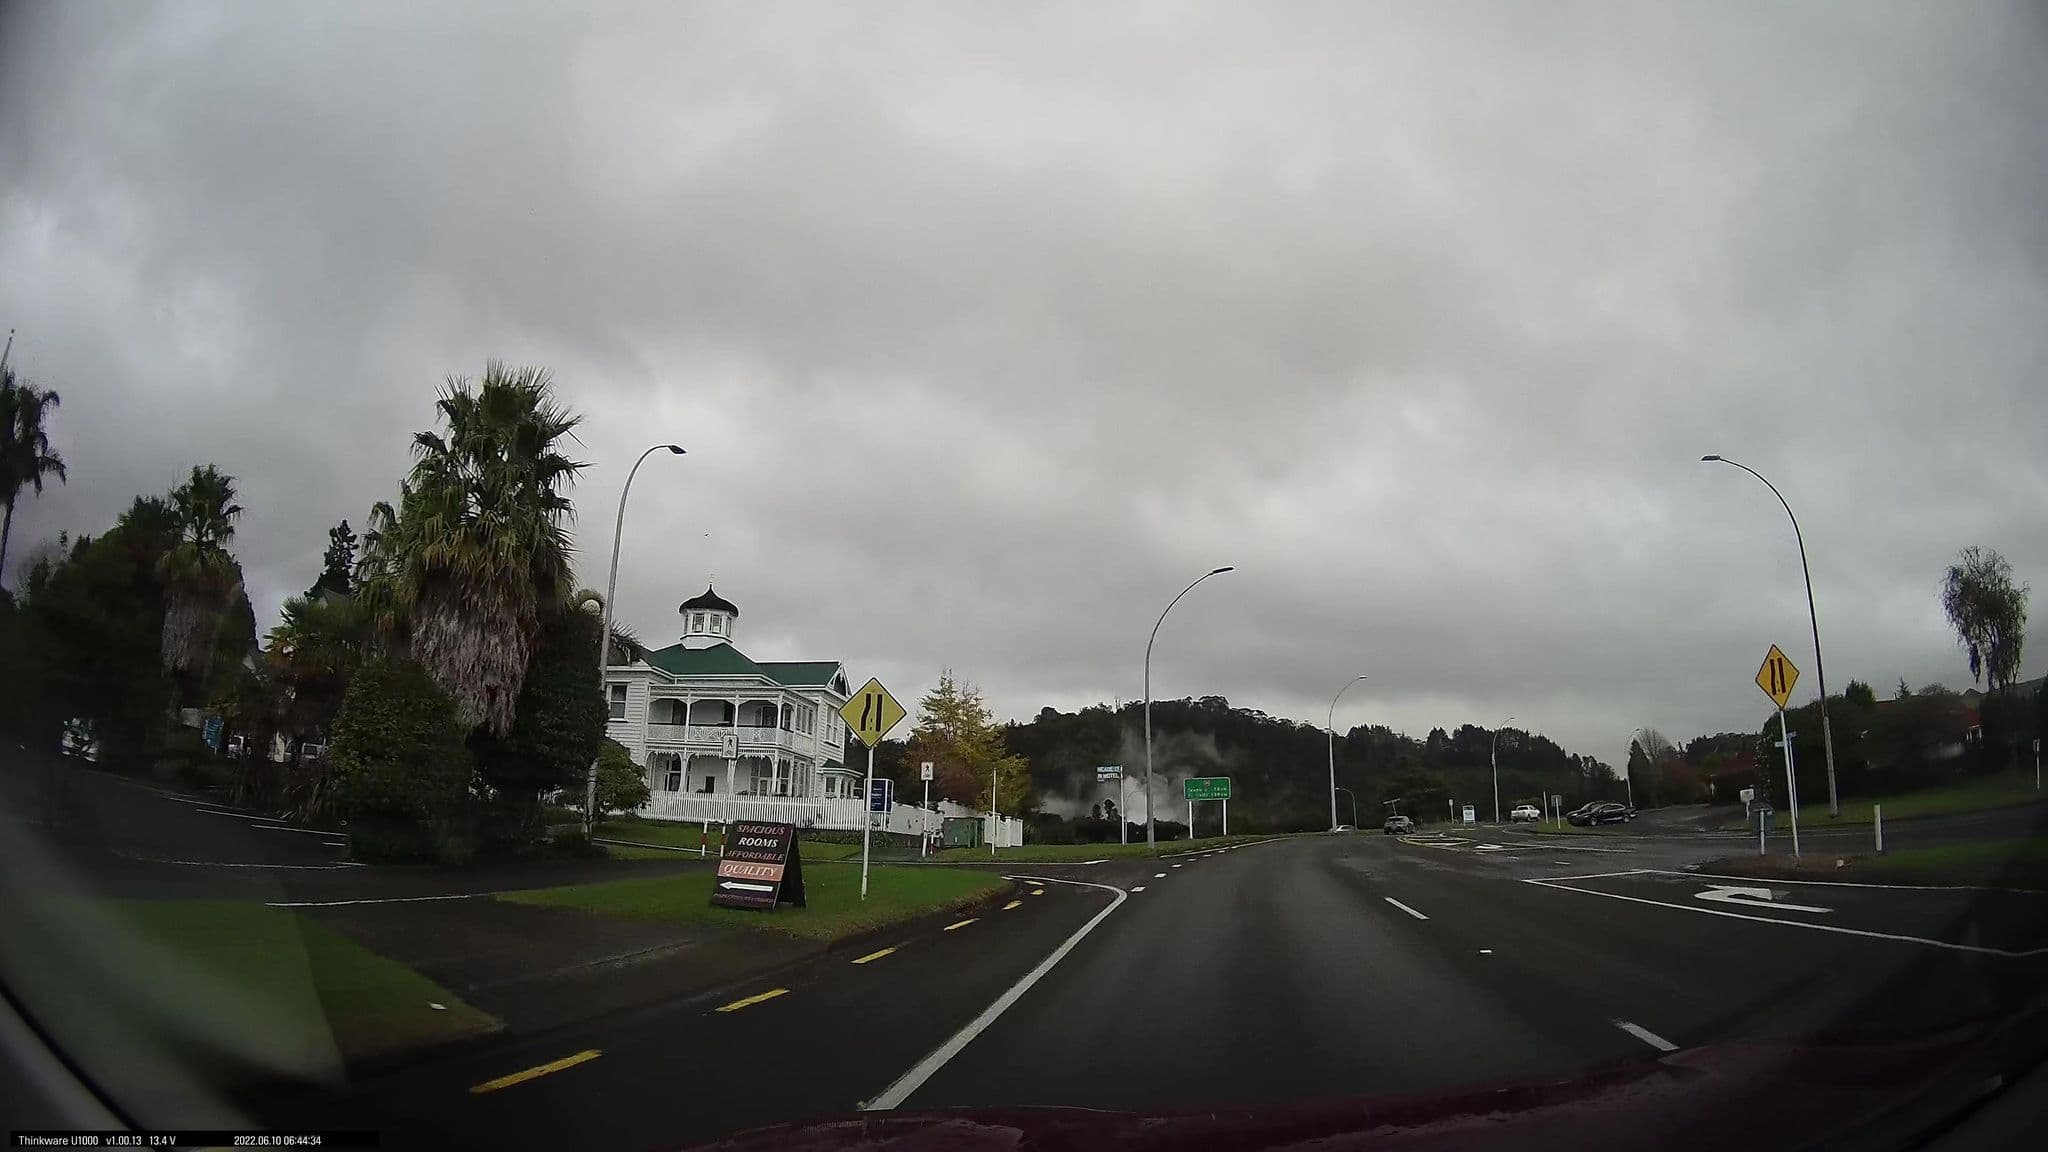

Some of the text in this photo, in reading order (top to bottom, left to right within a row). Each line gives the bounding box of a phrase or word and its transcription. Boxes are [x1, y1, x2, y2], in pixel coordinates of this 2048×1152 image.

[737, 824, 785, 835] SPACIOUS
[738, 837, 779, 848] ROOMS
[725, 850, 785, 861] AFFORDABLE
[723, 864, 778, 877] QUALITY
